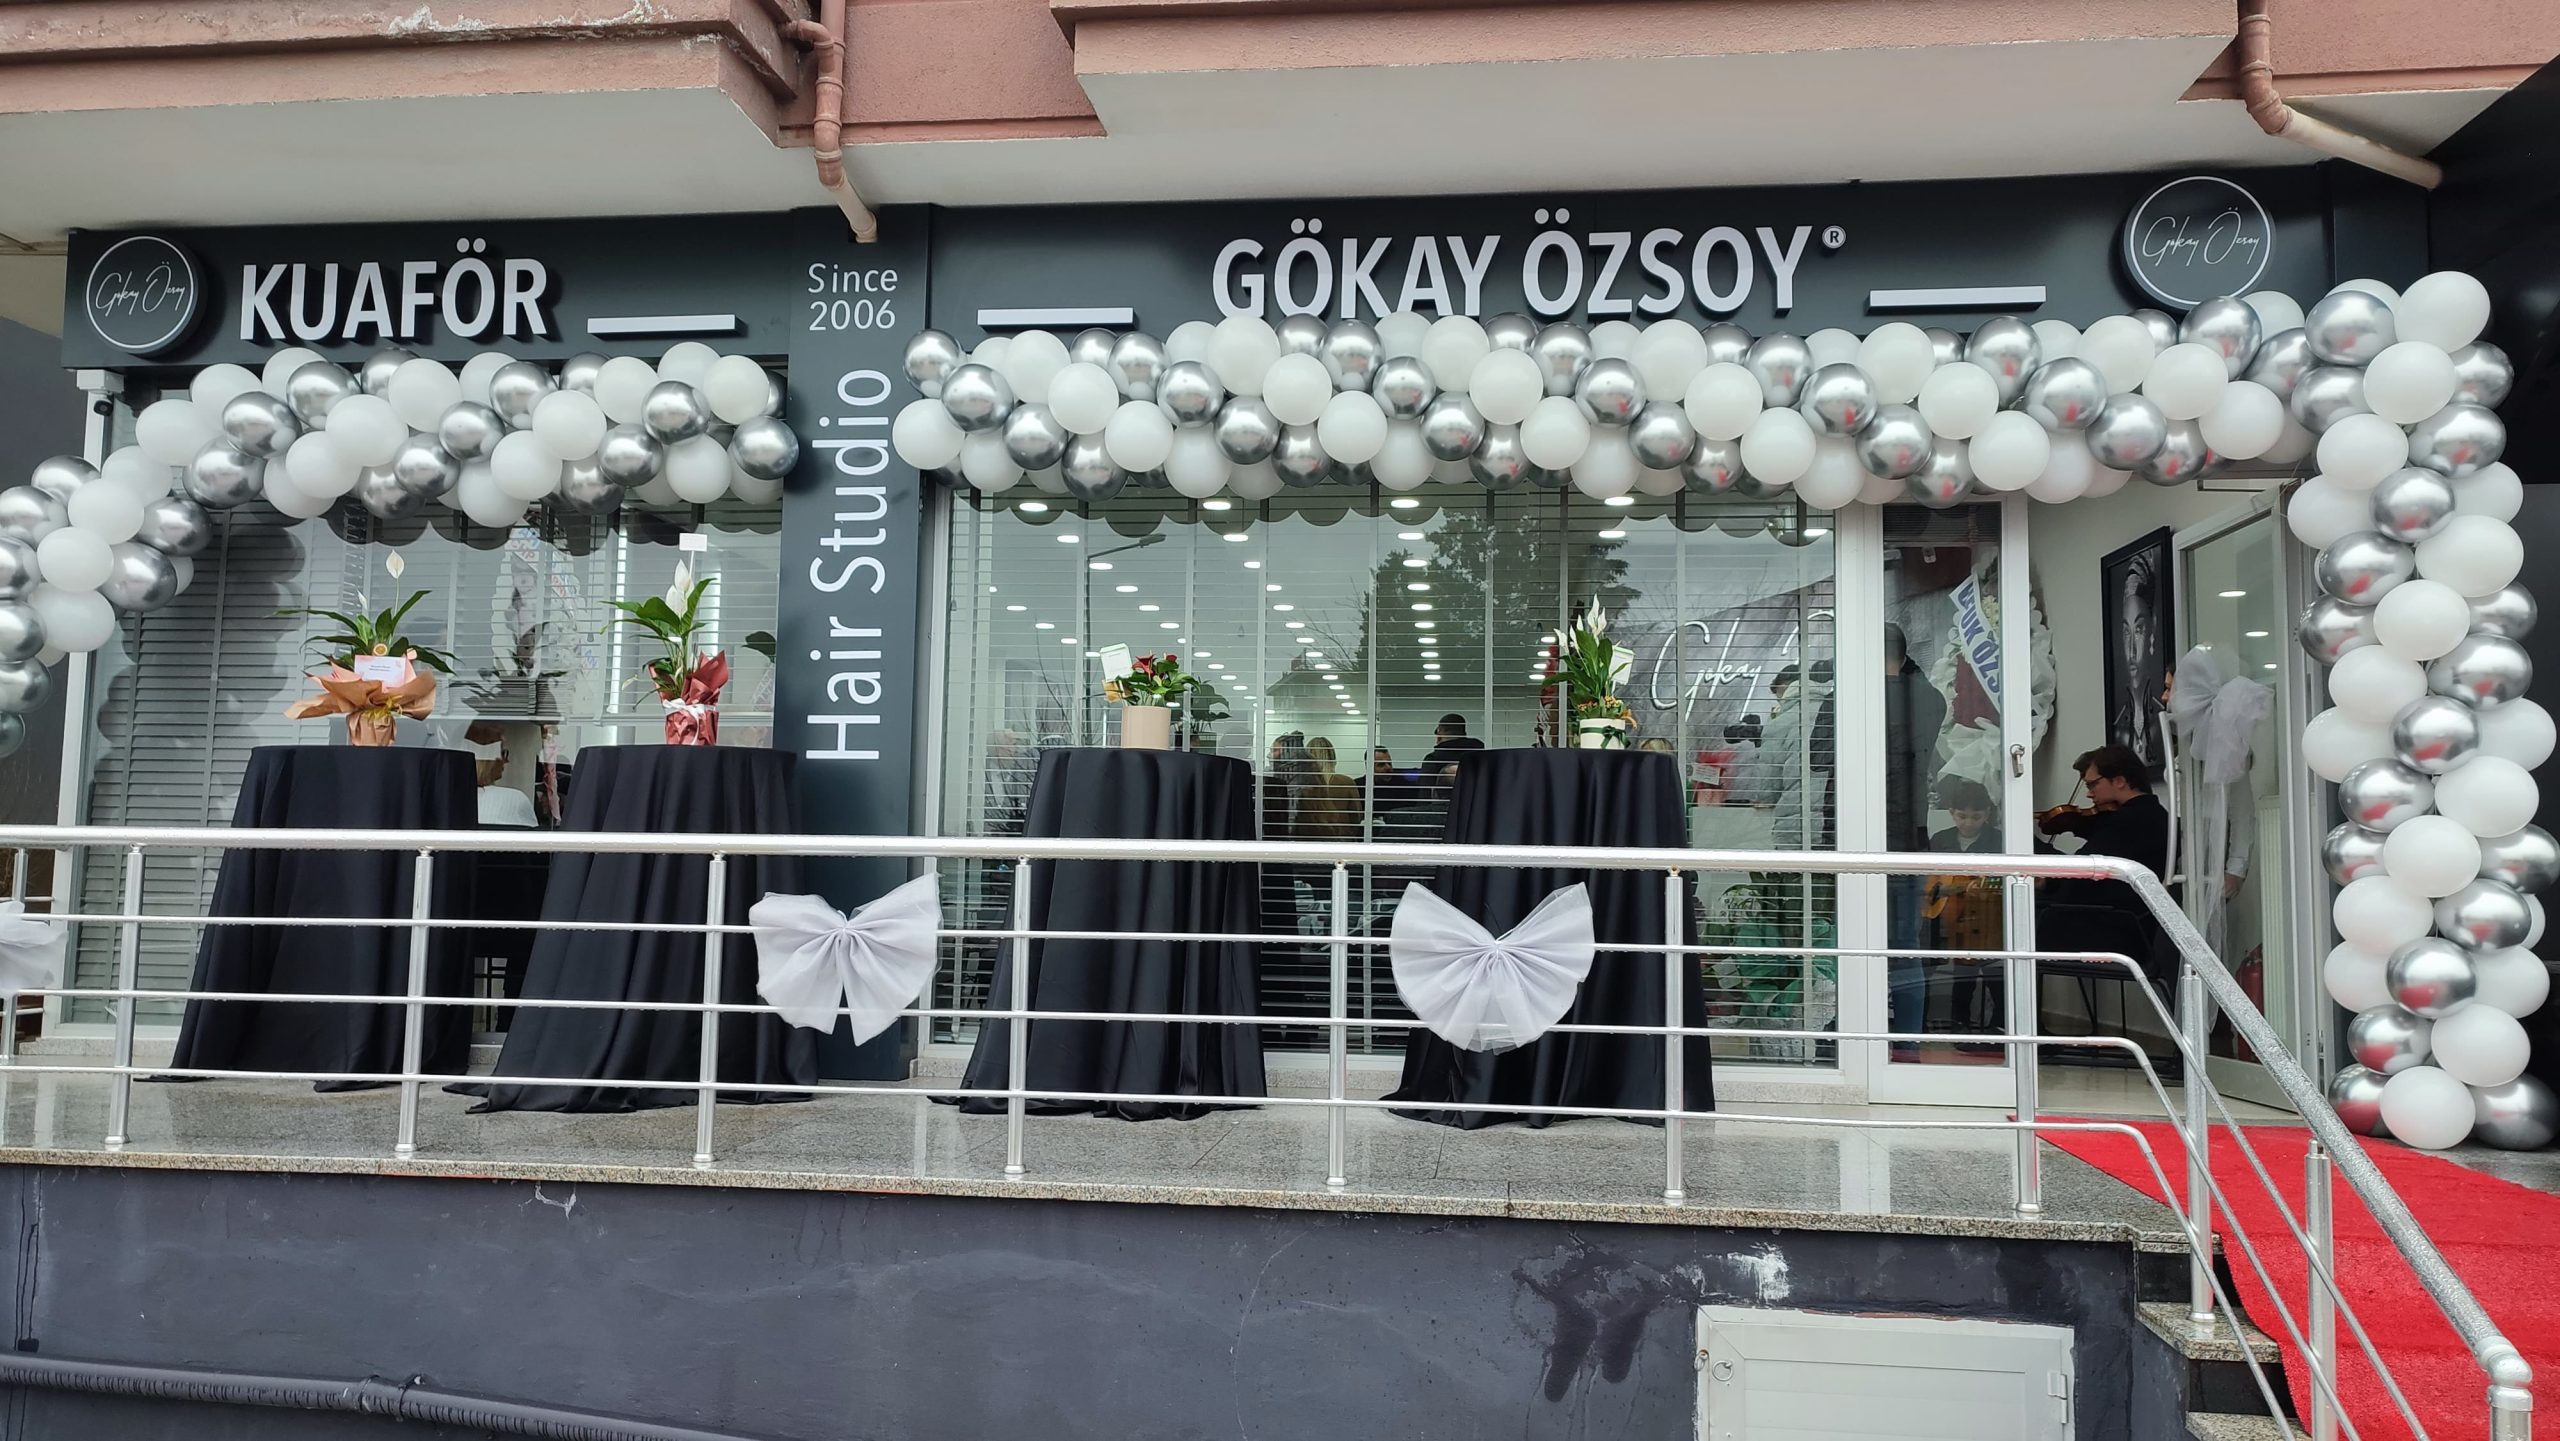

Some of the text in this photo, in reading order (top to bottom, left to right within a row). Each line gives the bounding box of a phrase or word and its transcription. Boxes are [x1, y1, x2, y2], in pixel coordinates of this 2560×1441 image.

[240, 237, 547, 341] KUAFÖR
[807, 262, 898, 293] Since
[809, 299, 896, 331] 2006
[1212, 217, 1501, 319] GÖKAY
[805, 369, 892, 760] Hair Studio
